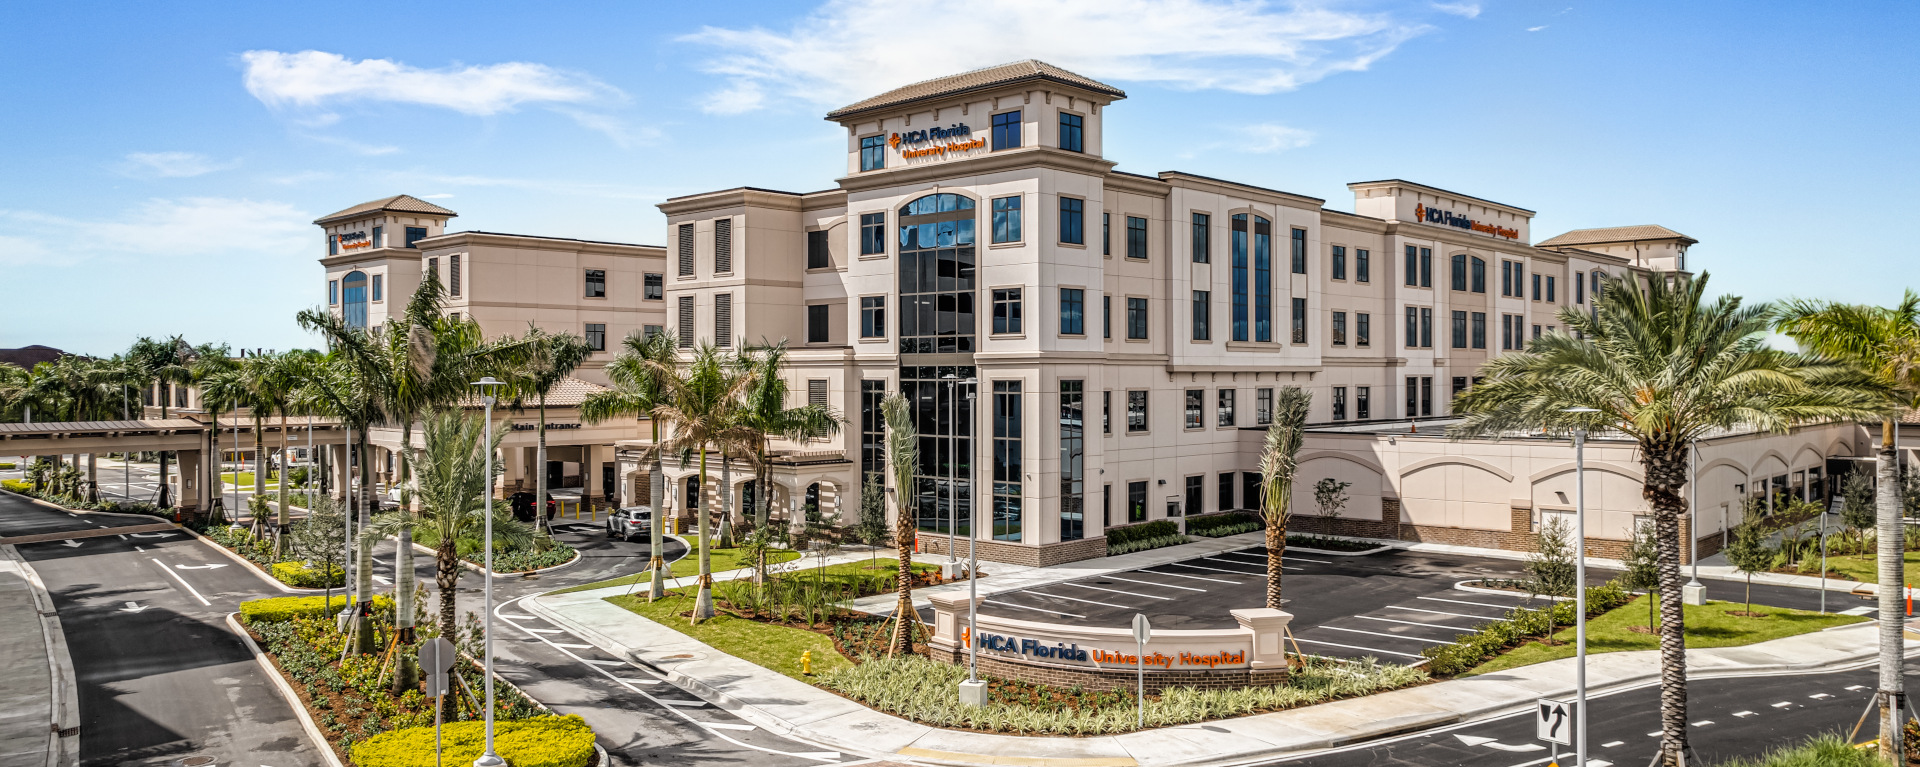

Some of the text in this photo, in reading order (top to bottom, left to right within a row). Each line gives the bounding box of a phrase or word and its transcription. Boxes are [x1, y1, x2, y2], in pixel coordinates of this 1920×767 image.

[902, 123, 970, 144] HCA Florida
[902, 137, 985, 159] University Hospital
[1425, 207, 1445, 224] HCA
[538, 422, 581, 431] ntrance
[980, 632, 1019, 654] HCA
[1021, 638, 1087, 661] Florida
[1179, 650, 1245, 668] Hospital
